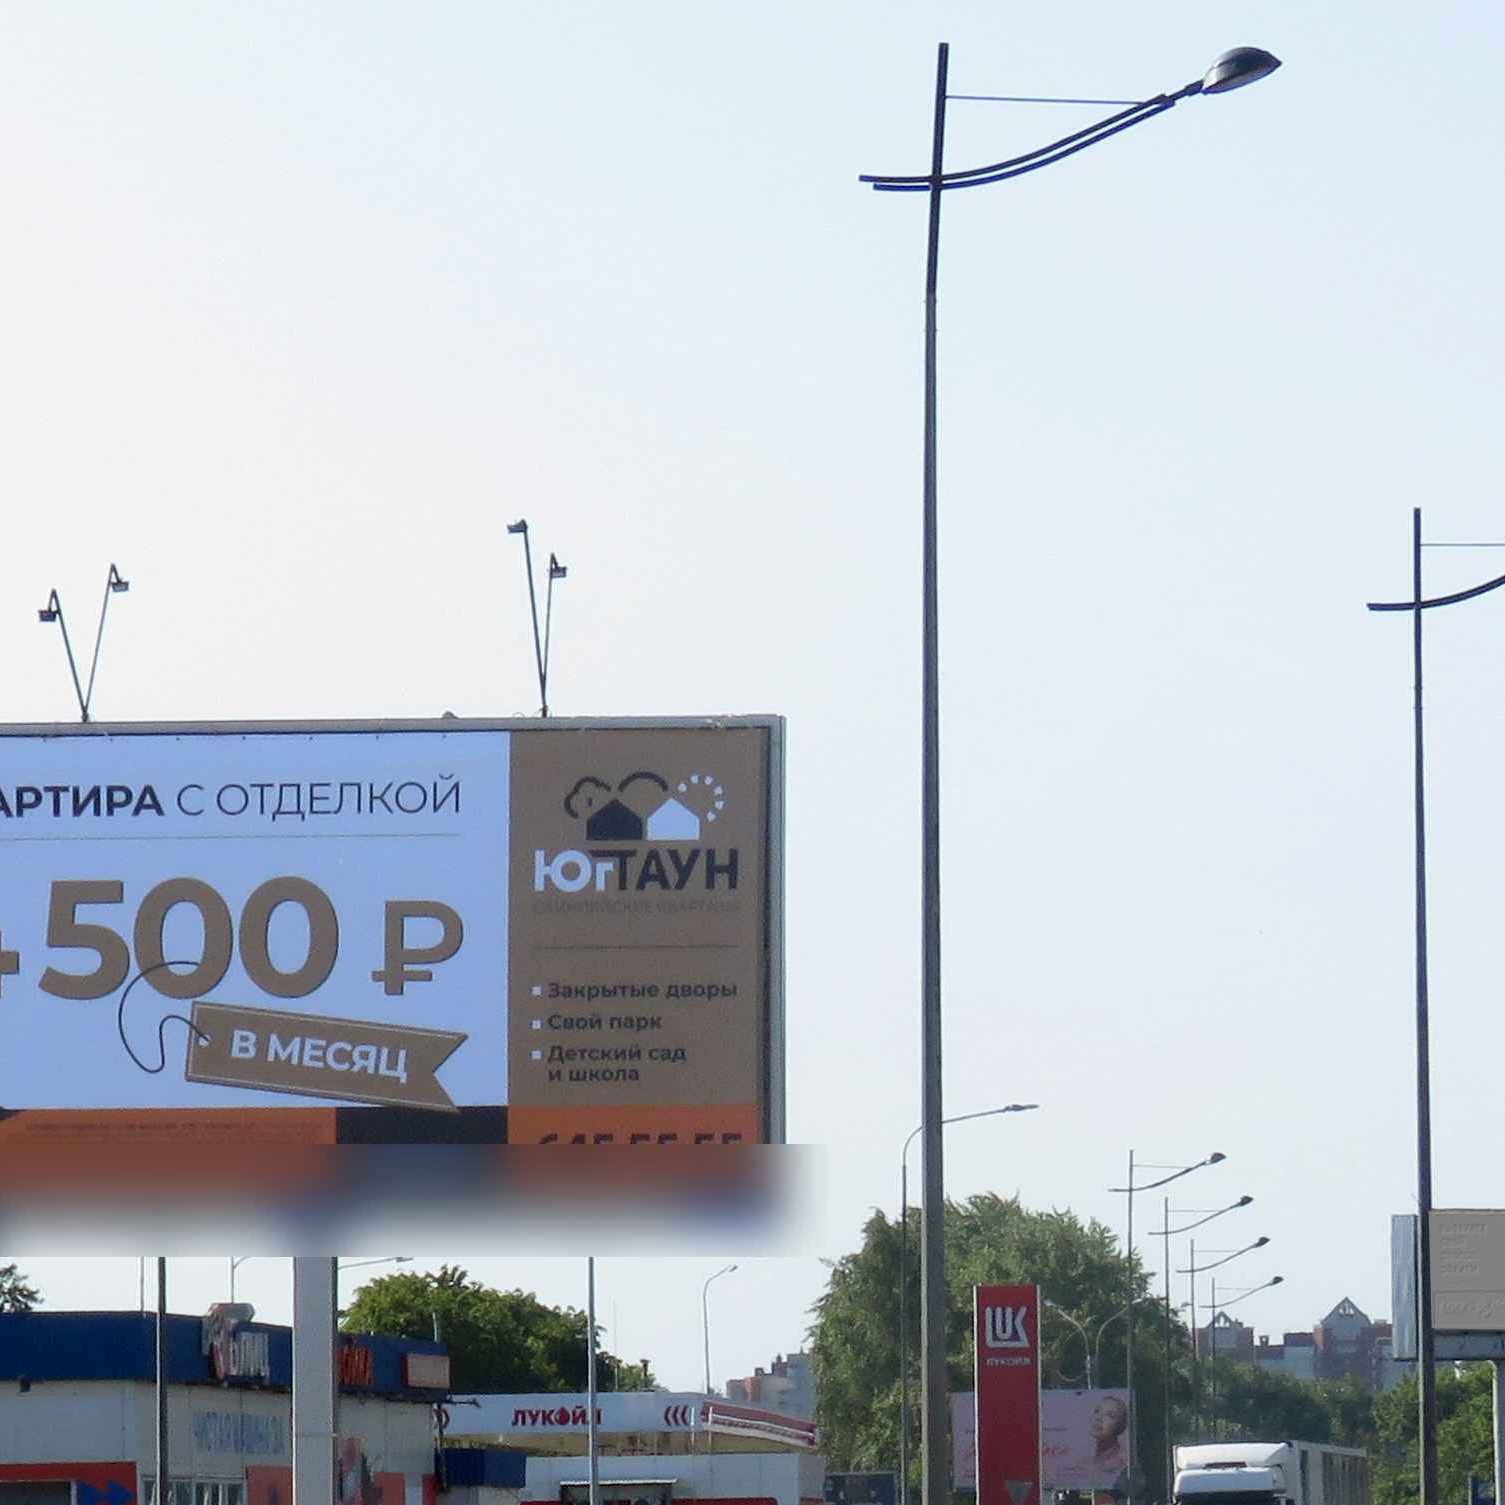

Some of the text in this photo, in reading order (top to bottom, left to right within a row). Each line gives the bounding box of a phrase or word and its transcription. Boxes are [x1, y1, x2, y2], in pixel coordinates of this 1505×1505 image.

[177, 784, 205, 816] С
[216, 774, 460, 822] ОТДЕЛКОЙ
[548, 982, 737, 1001] Закрытые дворы
[548, 1014, 662, 1031] Свой парк
[230, 1029, 408, 1084] В МЕСЯЦ
[548, 1046, 687, 1063] Детский сад
[548, 1068, 640, 1082] и школа
